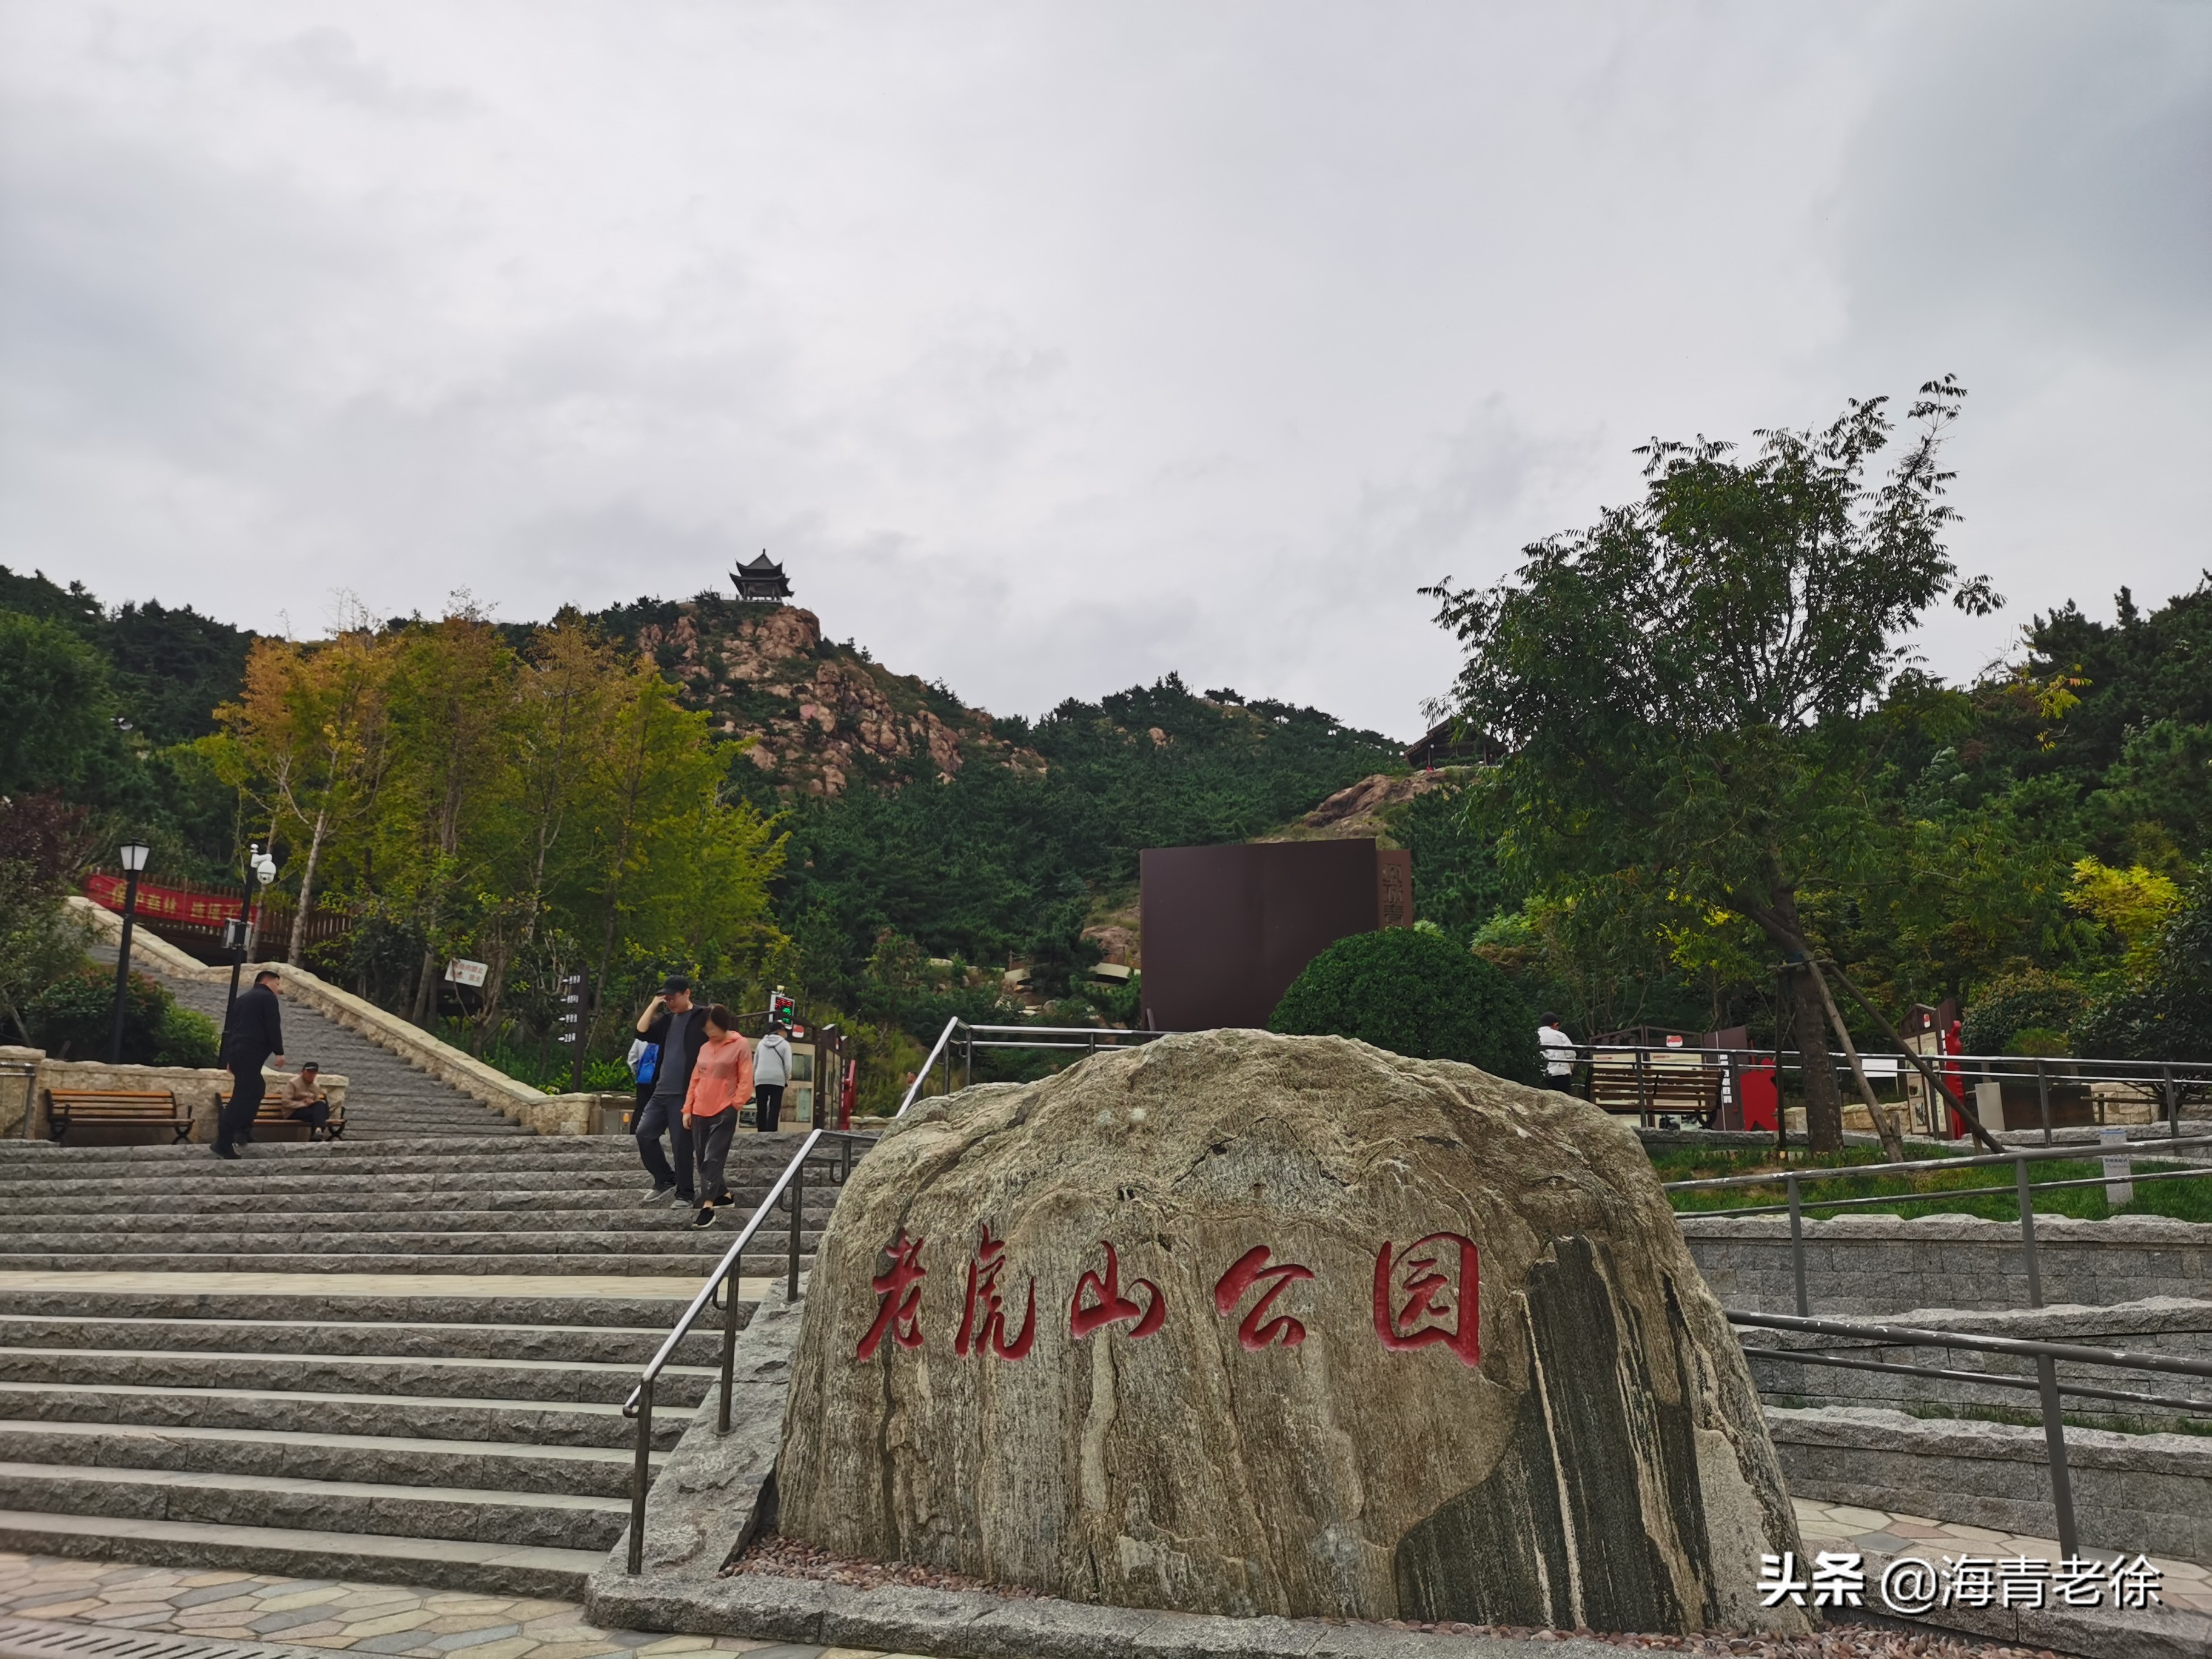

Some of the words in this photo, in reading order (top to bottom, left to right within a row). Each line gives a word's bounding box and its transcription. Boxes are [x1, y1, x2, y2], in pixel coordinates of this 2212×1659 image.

[856, 1222, 1480, 1367] 老虎山公园
